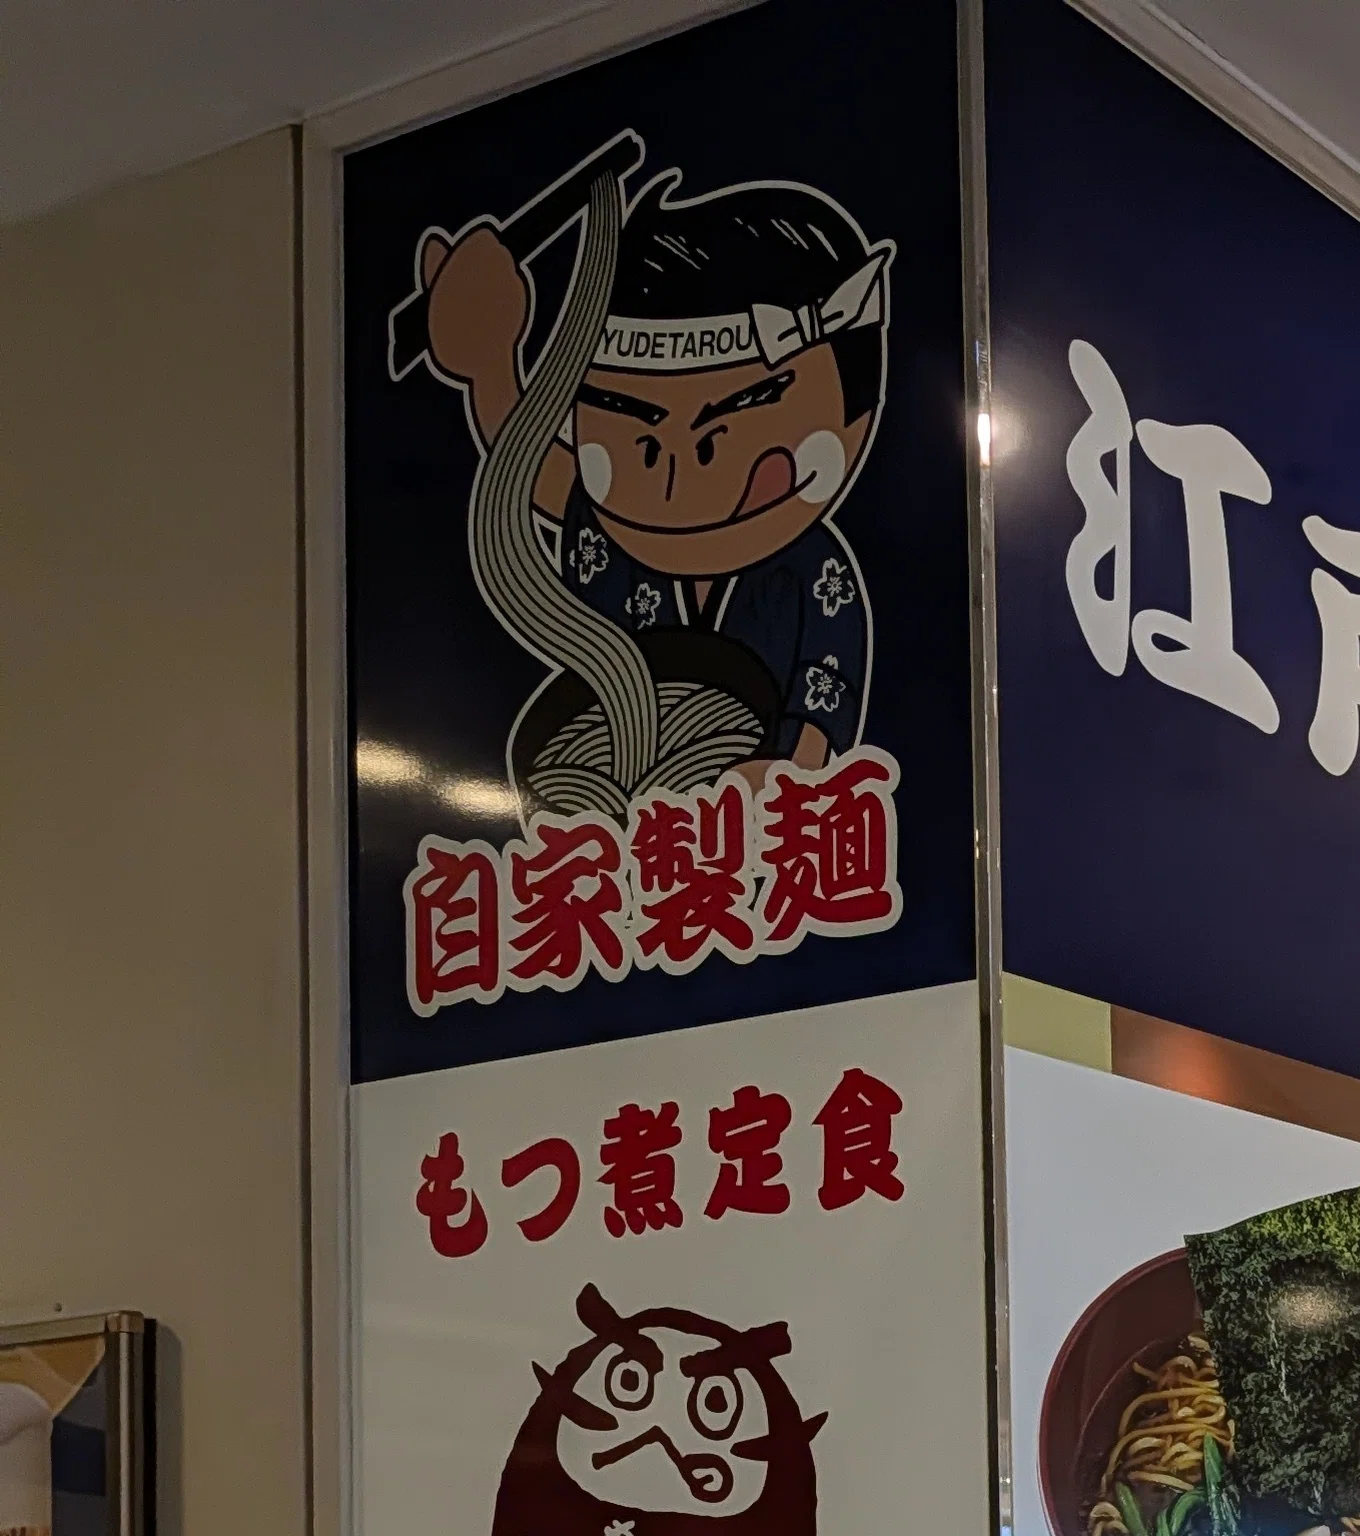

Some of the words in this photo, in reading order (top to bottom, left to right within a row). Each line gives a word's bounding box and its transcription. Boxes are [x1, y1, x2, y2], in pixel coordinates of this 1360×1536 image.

[602, 317, 754, 361] YUDETAROU
[412, 758, 890, 1004] 自家製麺
[416, 1068, 905, 1258] もつ煮定食
